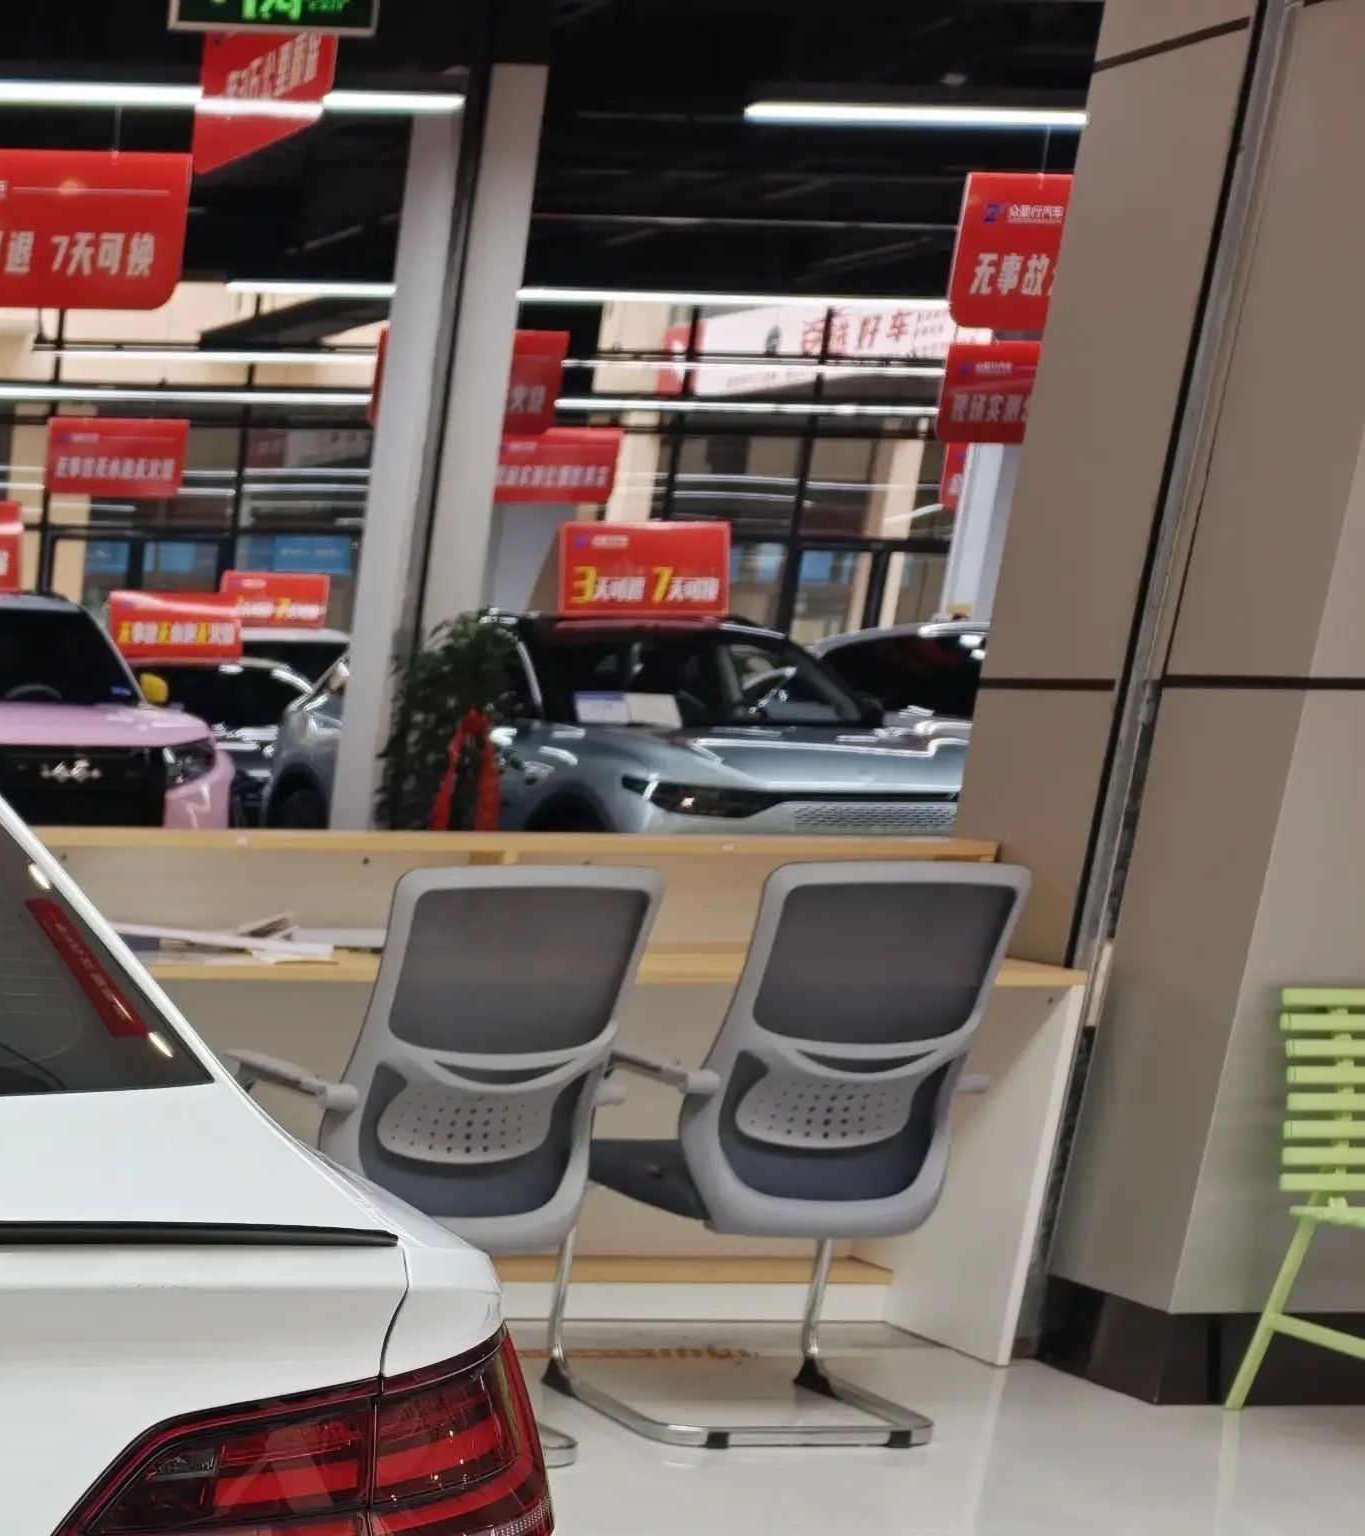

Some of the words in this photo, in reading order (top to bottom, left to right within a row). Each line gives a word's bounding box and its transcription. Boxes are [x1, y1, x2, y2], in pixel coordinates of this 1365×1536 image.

[51, 232, 155, 277] 7天可换
[969, 252, 1057, 296] 无事故
